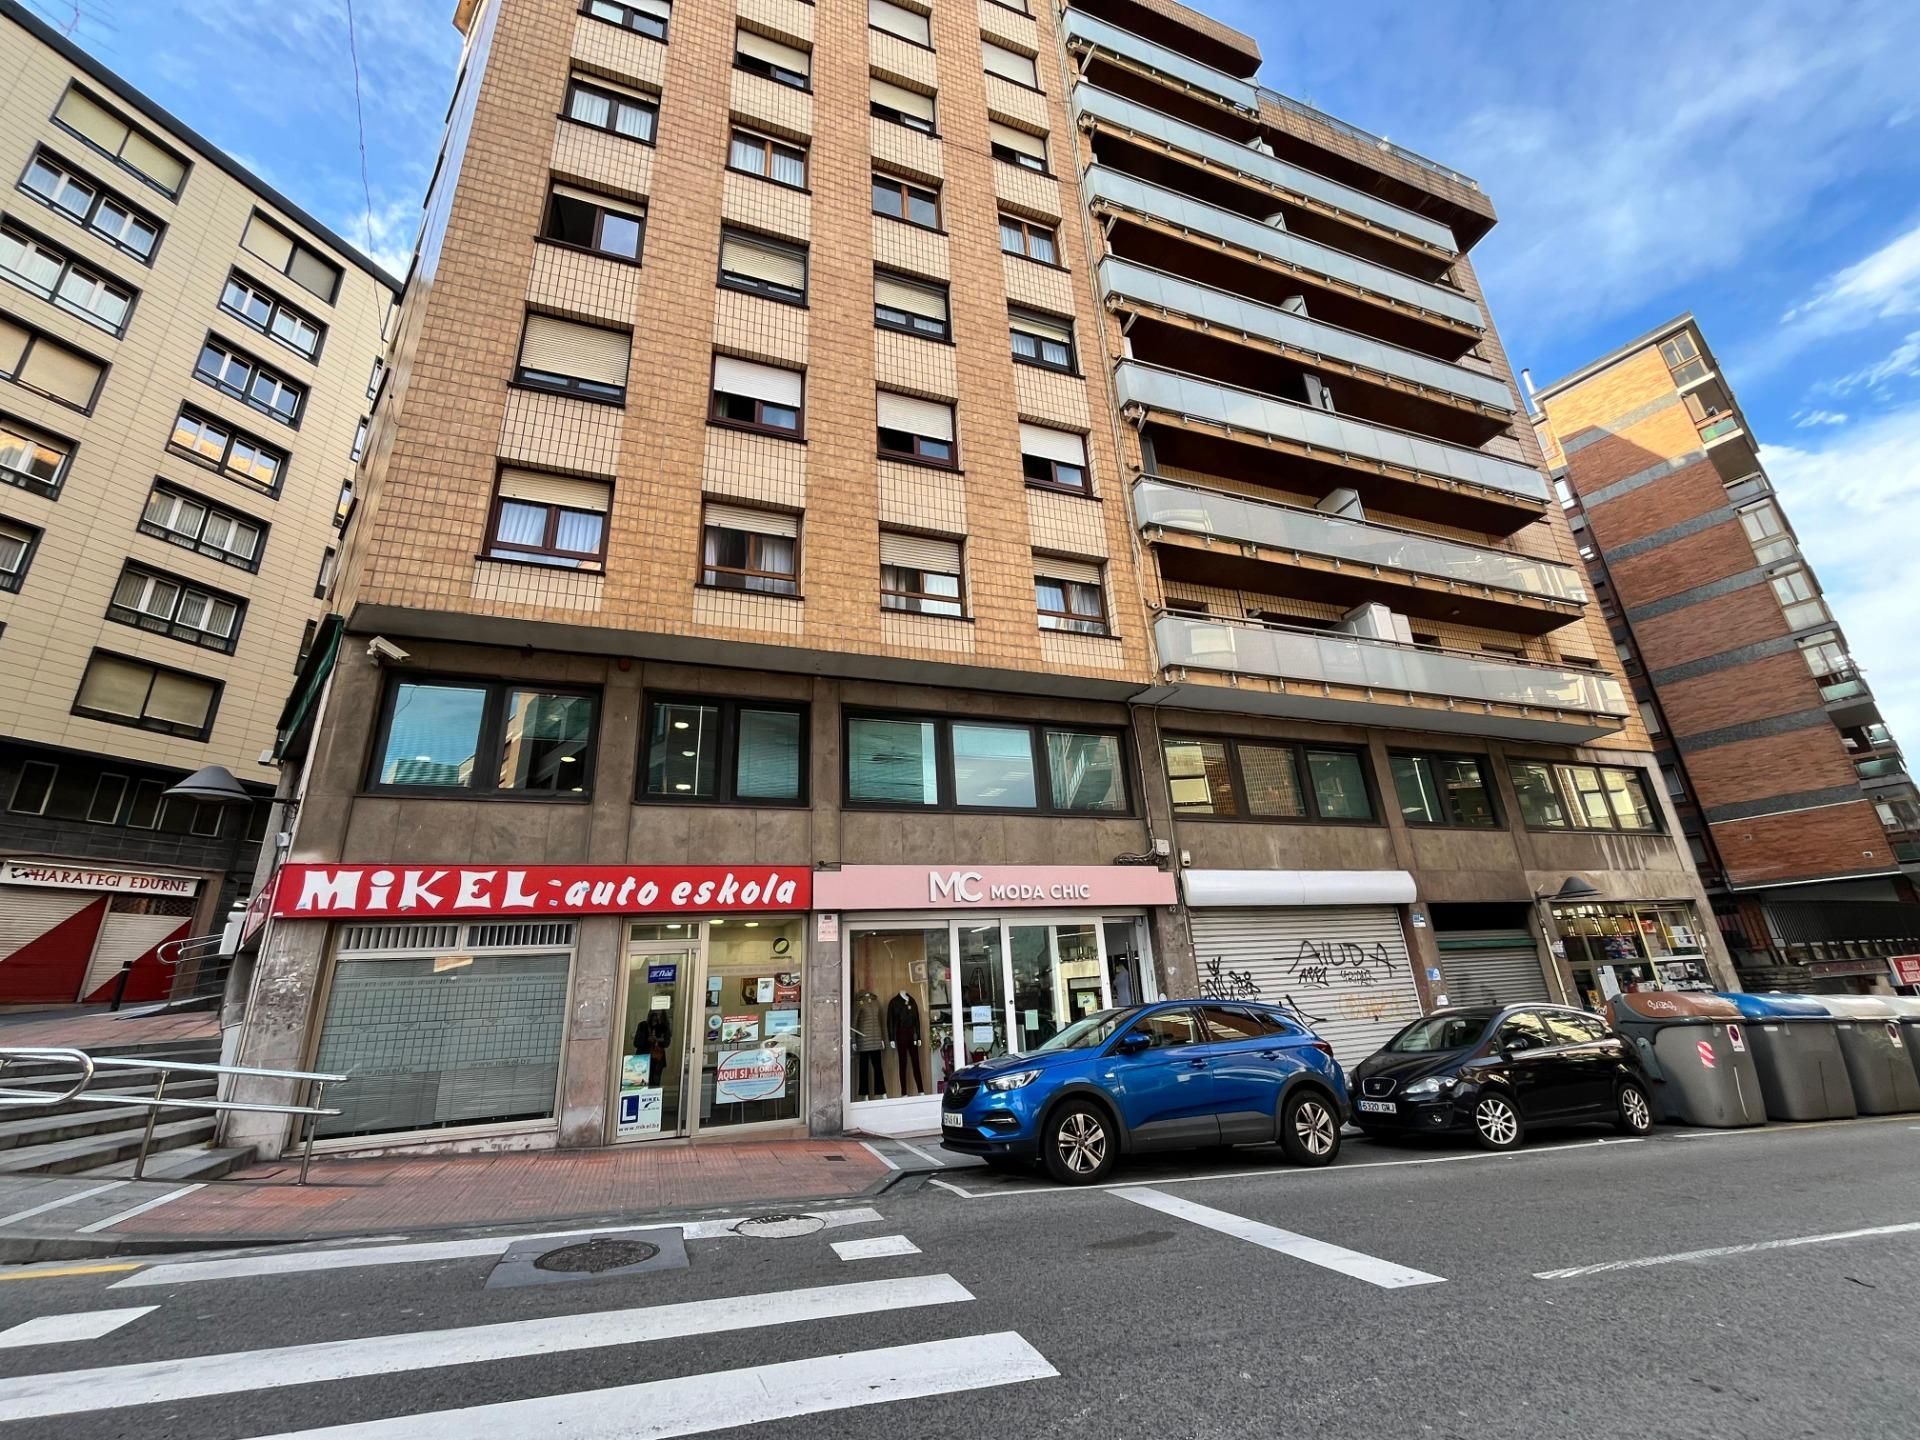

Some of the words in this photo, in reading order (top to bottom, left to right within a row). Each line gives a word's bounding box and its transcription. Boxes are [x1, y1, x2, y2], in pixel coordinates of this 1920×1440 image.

[129, 876, 189, 892] EDURNE
[564, 876, 659, 907] auto
[670, 872, 797, 906] eskola
[928, 871, 983, 902] MC
[990, 884, 1045, 900] MODA
[1049, 883, 1091, 899] CHIC
